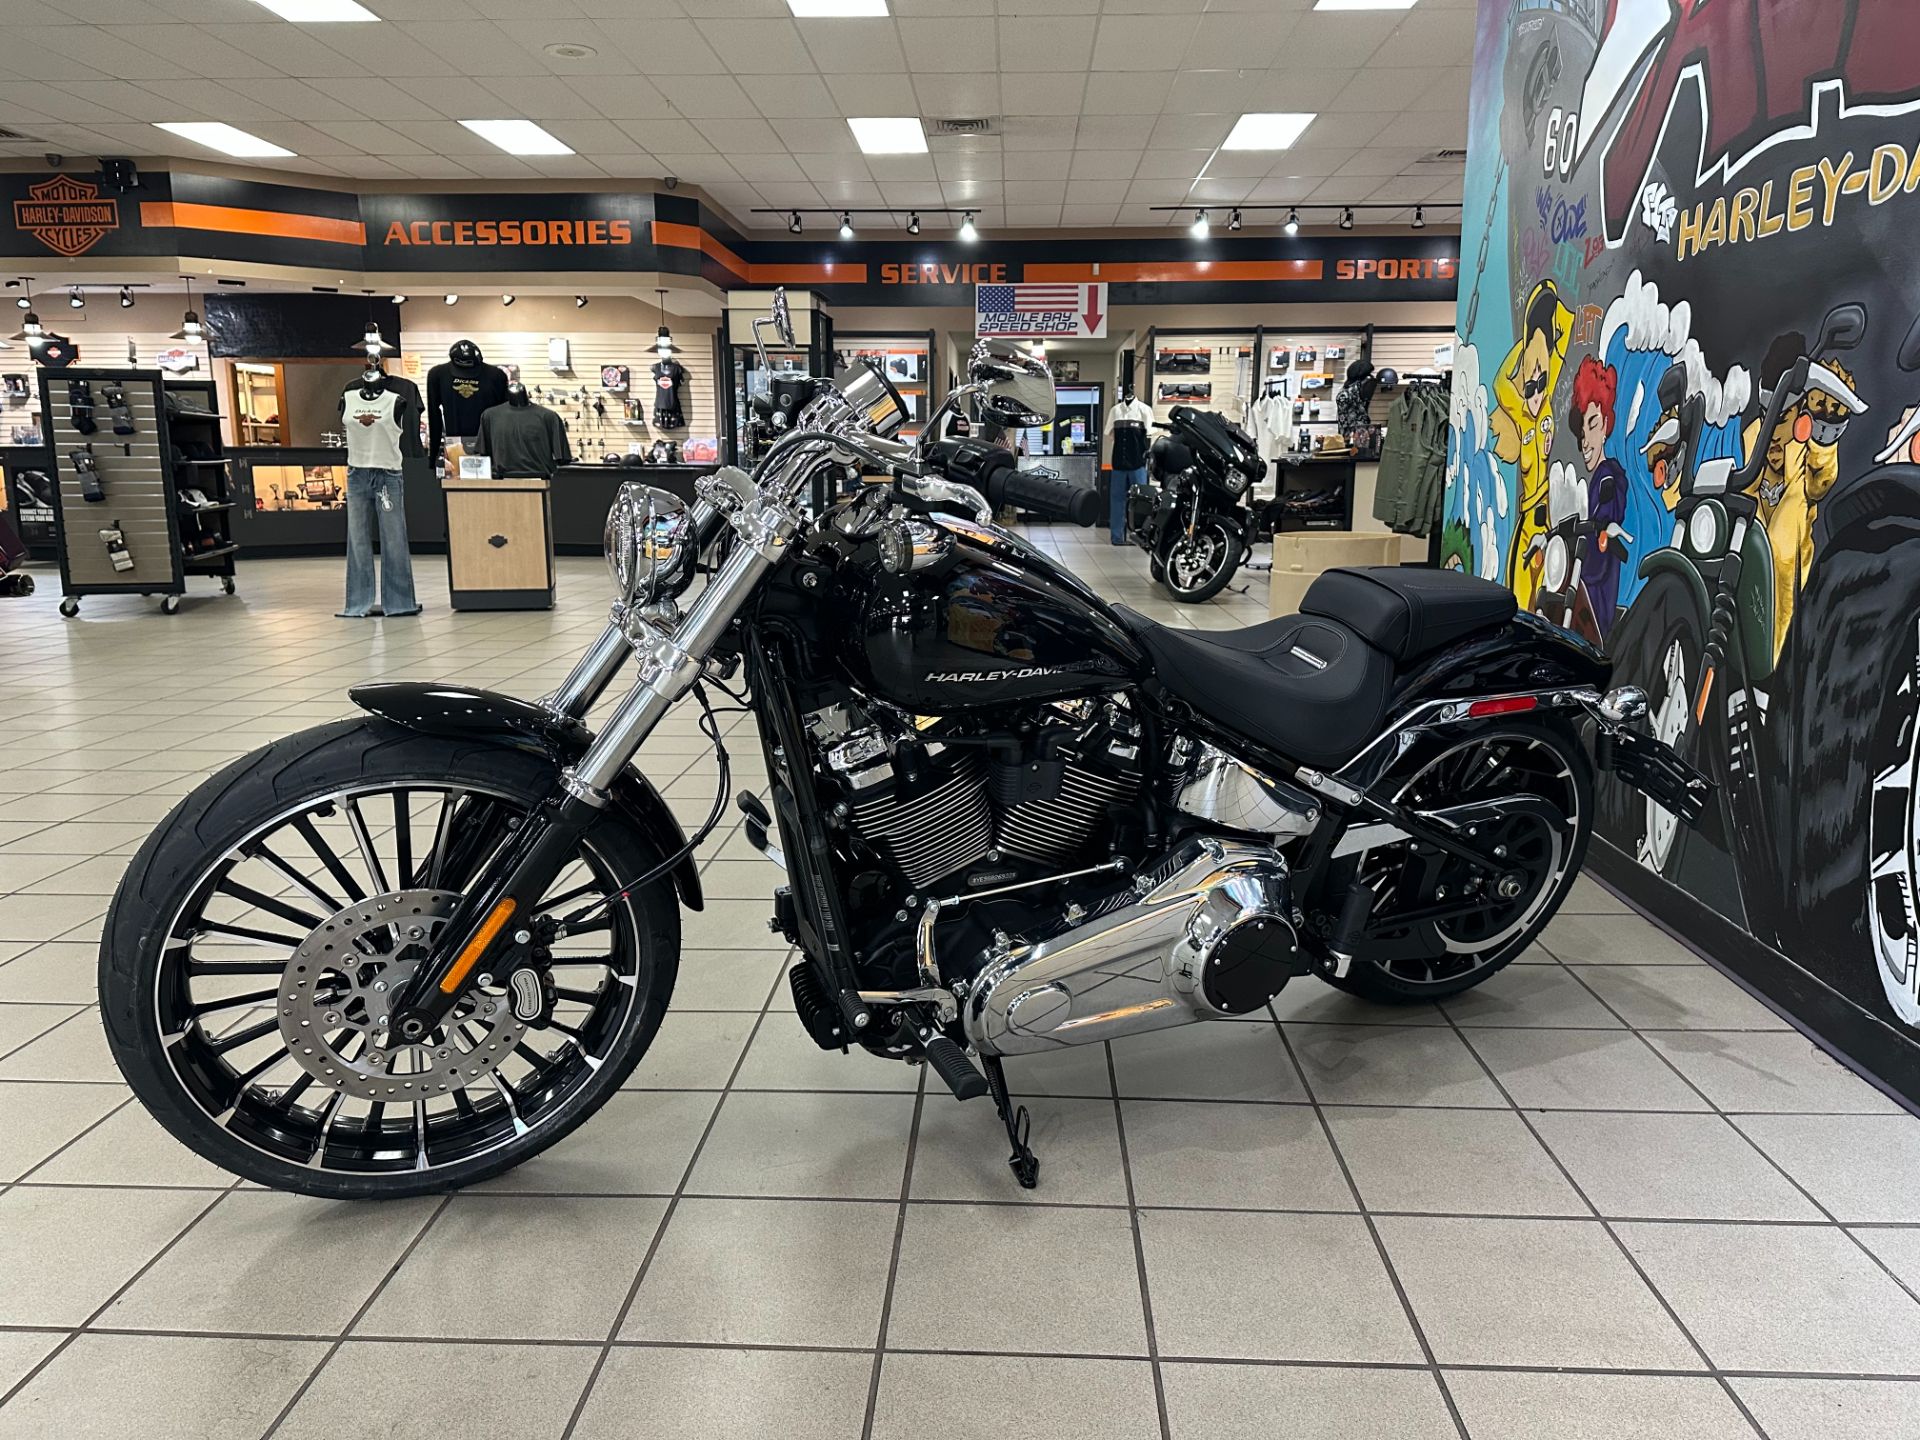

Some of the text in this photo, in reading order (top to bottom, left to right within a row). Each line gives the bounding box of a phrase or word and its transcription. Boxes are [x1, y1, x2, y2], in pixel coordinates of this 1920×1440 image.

[1543, 108, 1578, 172] 60
[40, 182, 88, 201] MOTOR
[21, 206, 112, 224] HARLEY-DAVIDSON
[45, 228, 92, 250] CYCLES
[383, 220, 632, 246] ACCESSORIES
[880, 263, 1007, 284] SERVICE
[978, 322, 1078, 332] SPEED SHOP
[983, 312, 1072, 323] MOBILE BAY
